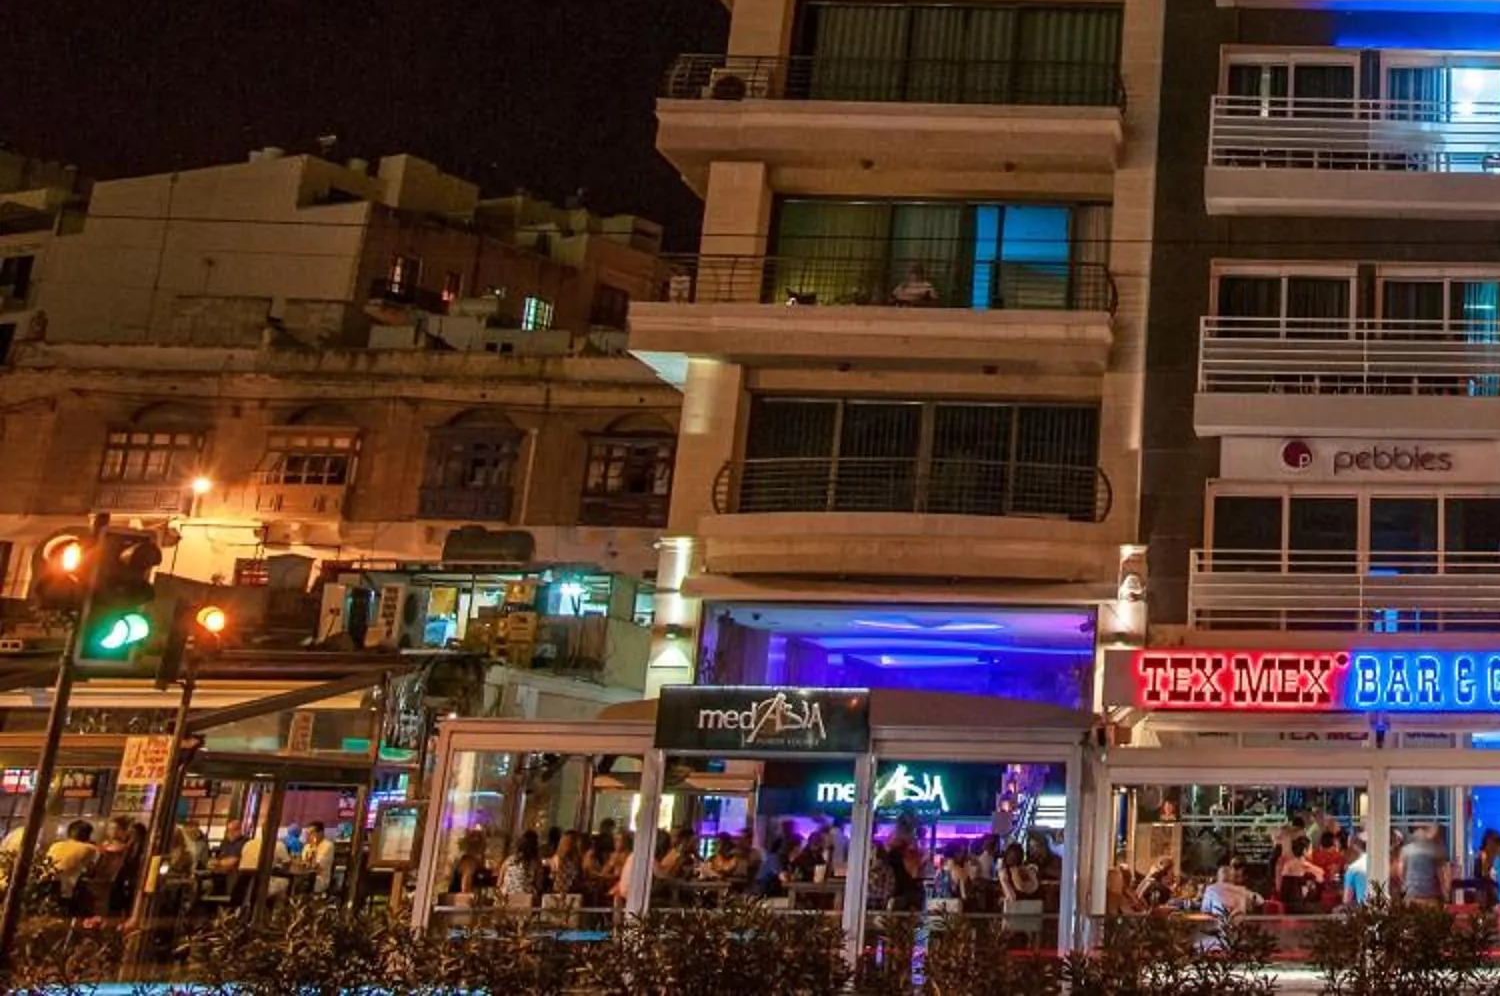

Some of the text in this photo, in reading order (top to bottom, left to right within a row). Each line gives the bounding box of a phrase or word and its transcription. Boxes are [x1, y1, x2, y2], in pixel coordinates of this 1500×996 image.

[1333, 446, 1453, 476] pebbles
[1139, 655, 1224, 704] TEX
[1231, 656, 1333, 704] MEX
[1354, 653, 1444, 705] BAR
[1454, 654, 1478, 705] &
